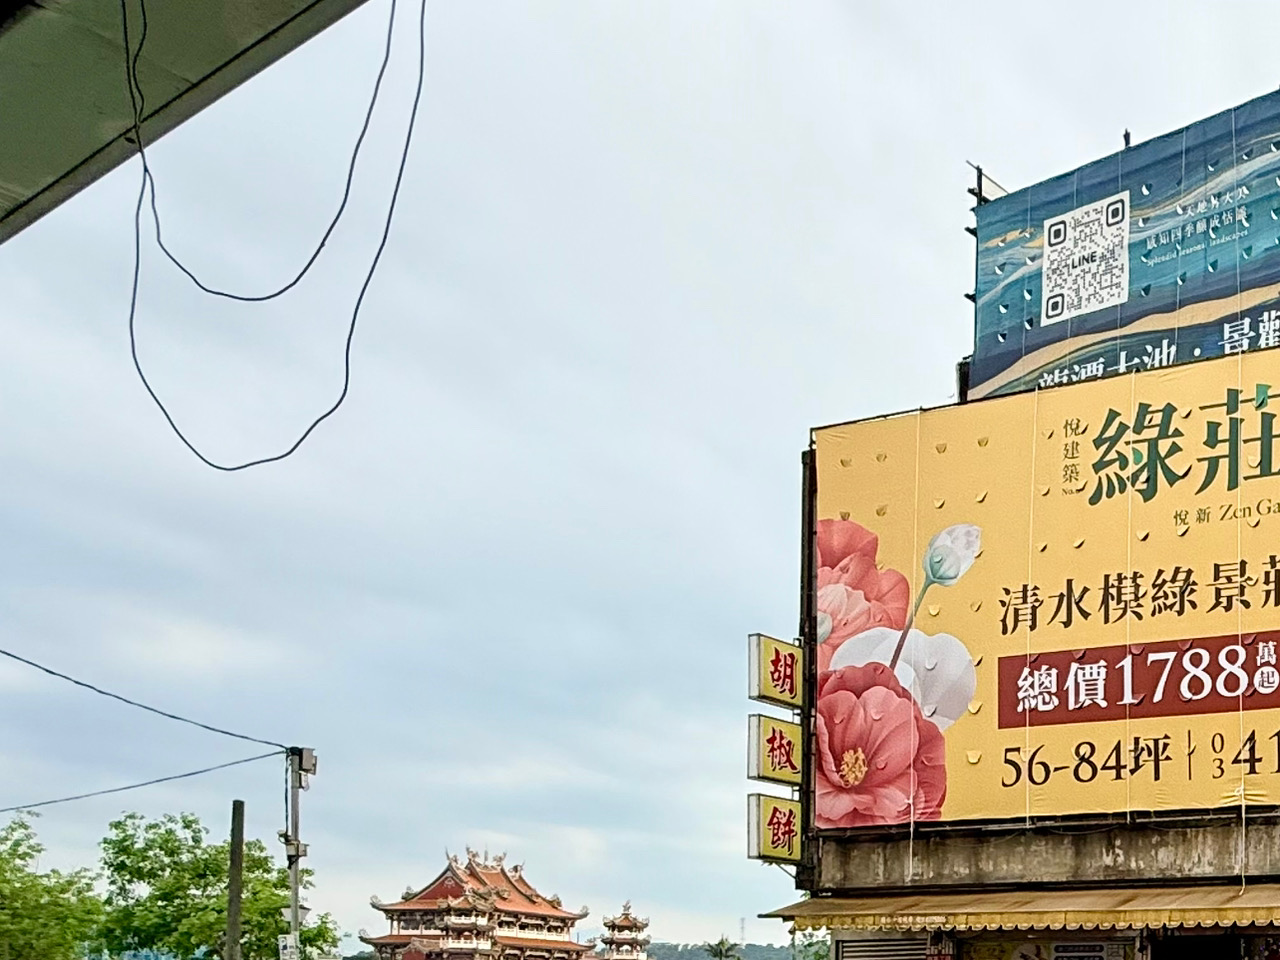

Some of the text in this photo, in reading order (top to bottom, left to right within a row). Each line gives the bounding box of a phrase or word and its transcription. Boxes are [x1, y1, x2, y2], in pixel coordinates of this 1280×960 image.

[1072, 251, 1097, 269] LINE
[1219, 503, 1252, 521] Zen
[1001, 733, 1173, 788] 56-84坪
